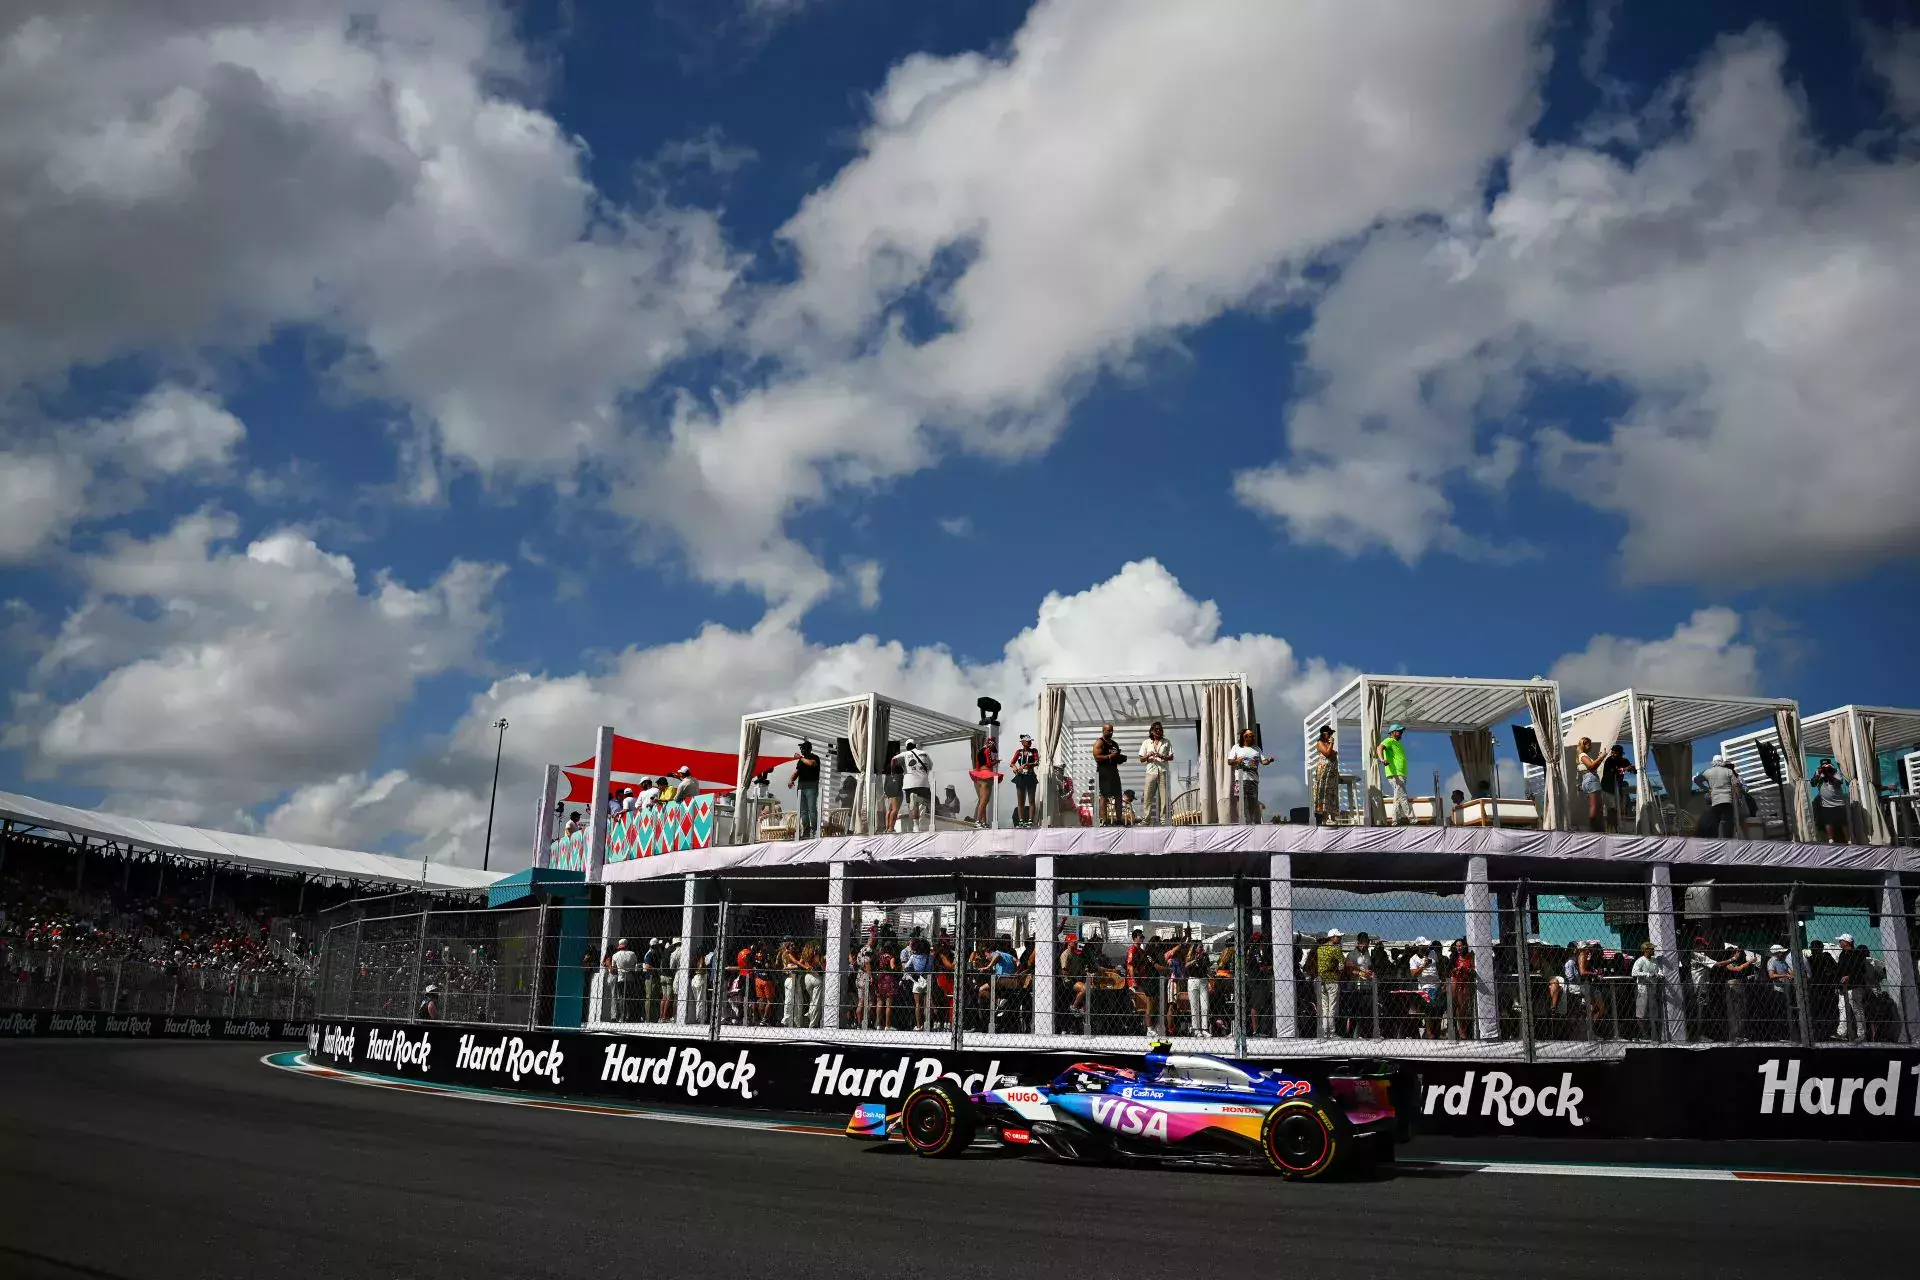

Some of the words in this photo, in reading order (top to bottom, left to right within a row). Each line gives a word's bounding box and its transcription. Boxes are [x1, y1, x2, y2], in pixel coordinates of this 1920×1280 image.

[0, 1013, 15, 1031] rd
[14, 1012, 37, 1034] Rock
[50, 1013, 76, 1031] Hard
[75, 1014, 96, 1034] Rock
[105, 1015, 130, 1031] Hard
[129, 1016, 151, 1036] Rock
[163, 1017, 189, 1033] Hard
[188, 1018, 211, 1036] Rock
[223, 1020, 248, 1035] Hard
[247, 1021, 270, 1038] Rock
[281, 1022, 306, 1036] Hard
[333, 1025, 354, 1062] Rock
[366, 1029, 396, 1061] Hard
[393, 1030, 431, 1072] Rock
[456, 1034, 506, 1071] Hard
[504, 1036, 564, 1084] Rock
[600, 1043, 676, 1086] Hard
[675, 1047, 757, 1099] Rock
[810, 1053, 910, 1099] Hard
[1007, 1092, 1038, 1102] HUGO
[1133, 1089, 1149, 1097] Cash
[1150, 1090, 1164, 1098] App
[1417, 1070, 1475, 1115] rd
[1481, 1072, 1585, 1127] Rock
[1757, 1059, 1902, 1116] Hard
[1092, 1095, 1168, 1142] VISA
[1222, 1106, 1260, 1114] HONDA
